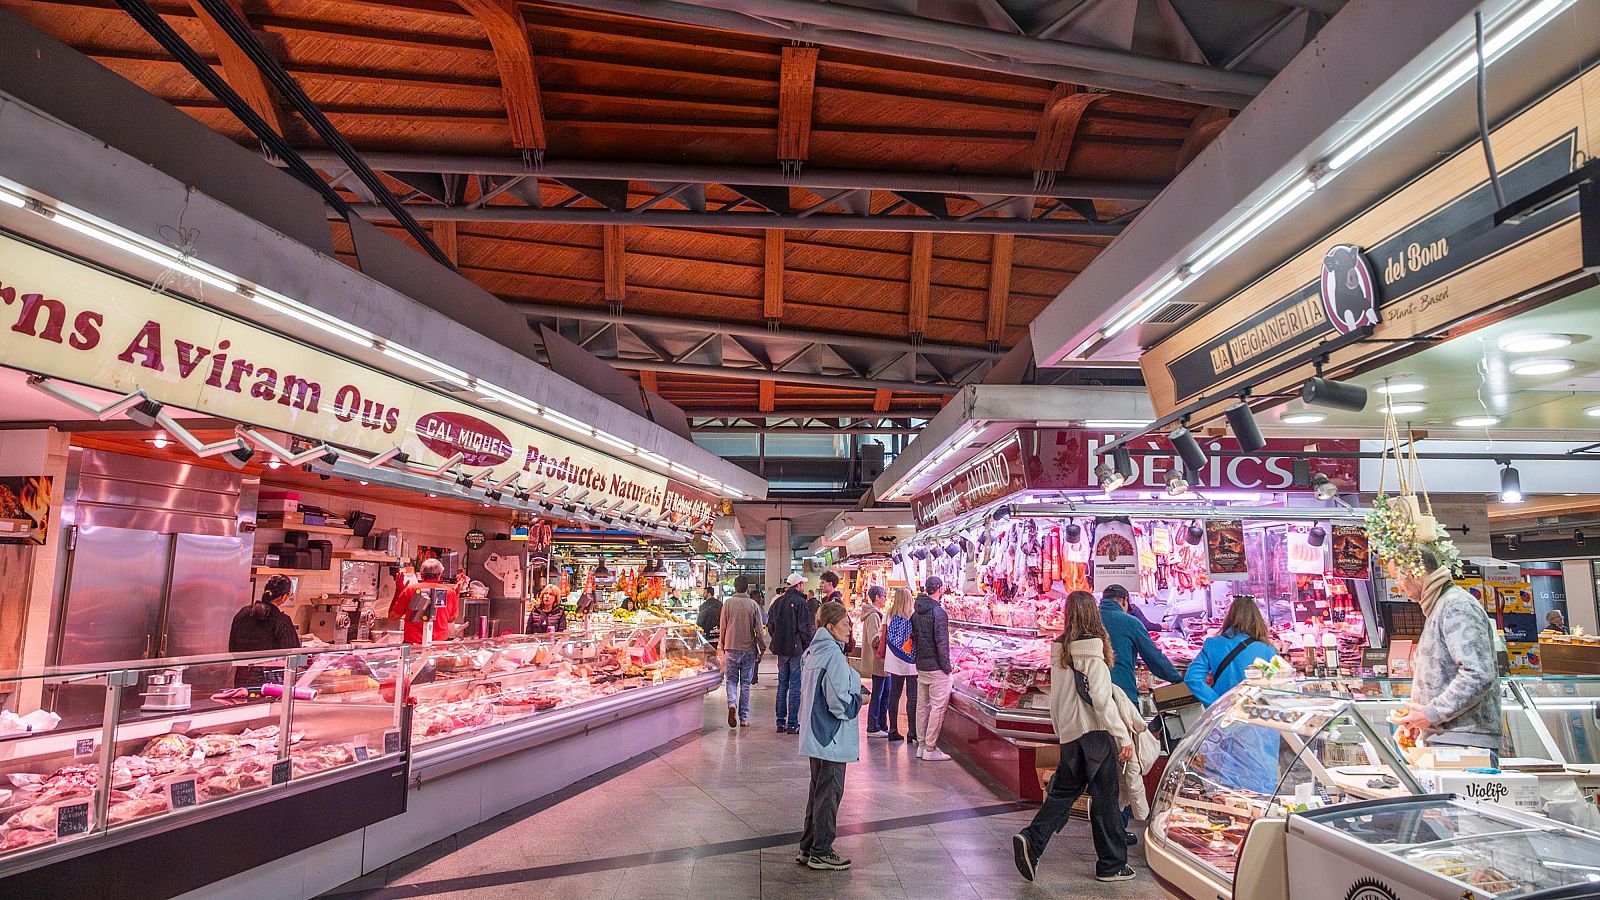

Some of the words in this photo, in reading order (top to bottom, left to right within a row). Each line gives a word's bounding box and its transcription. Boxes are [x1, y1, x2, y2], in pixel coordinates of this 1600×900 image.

[1384, 255, 1406, 285] del
[1408, 237, 1449, 271] Born
[1213, 348, 1231, 370] LA
[1234, 301, 1324, 360] VEGANERIA
[117, 320, 321, 415] Aviram
[333, 384, 399, 435] Ous
[425, 418, 453, 442] CAL
[457, 428, 505, 457] MIQUEL
[522, 444, 607, 493] Productes
[1465, 782, 1509, 803] Violife
